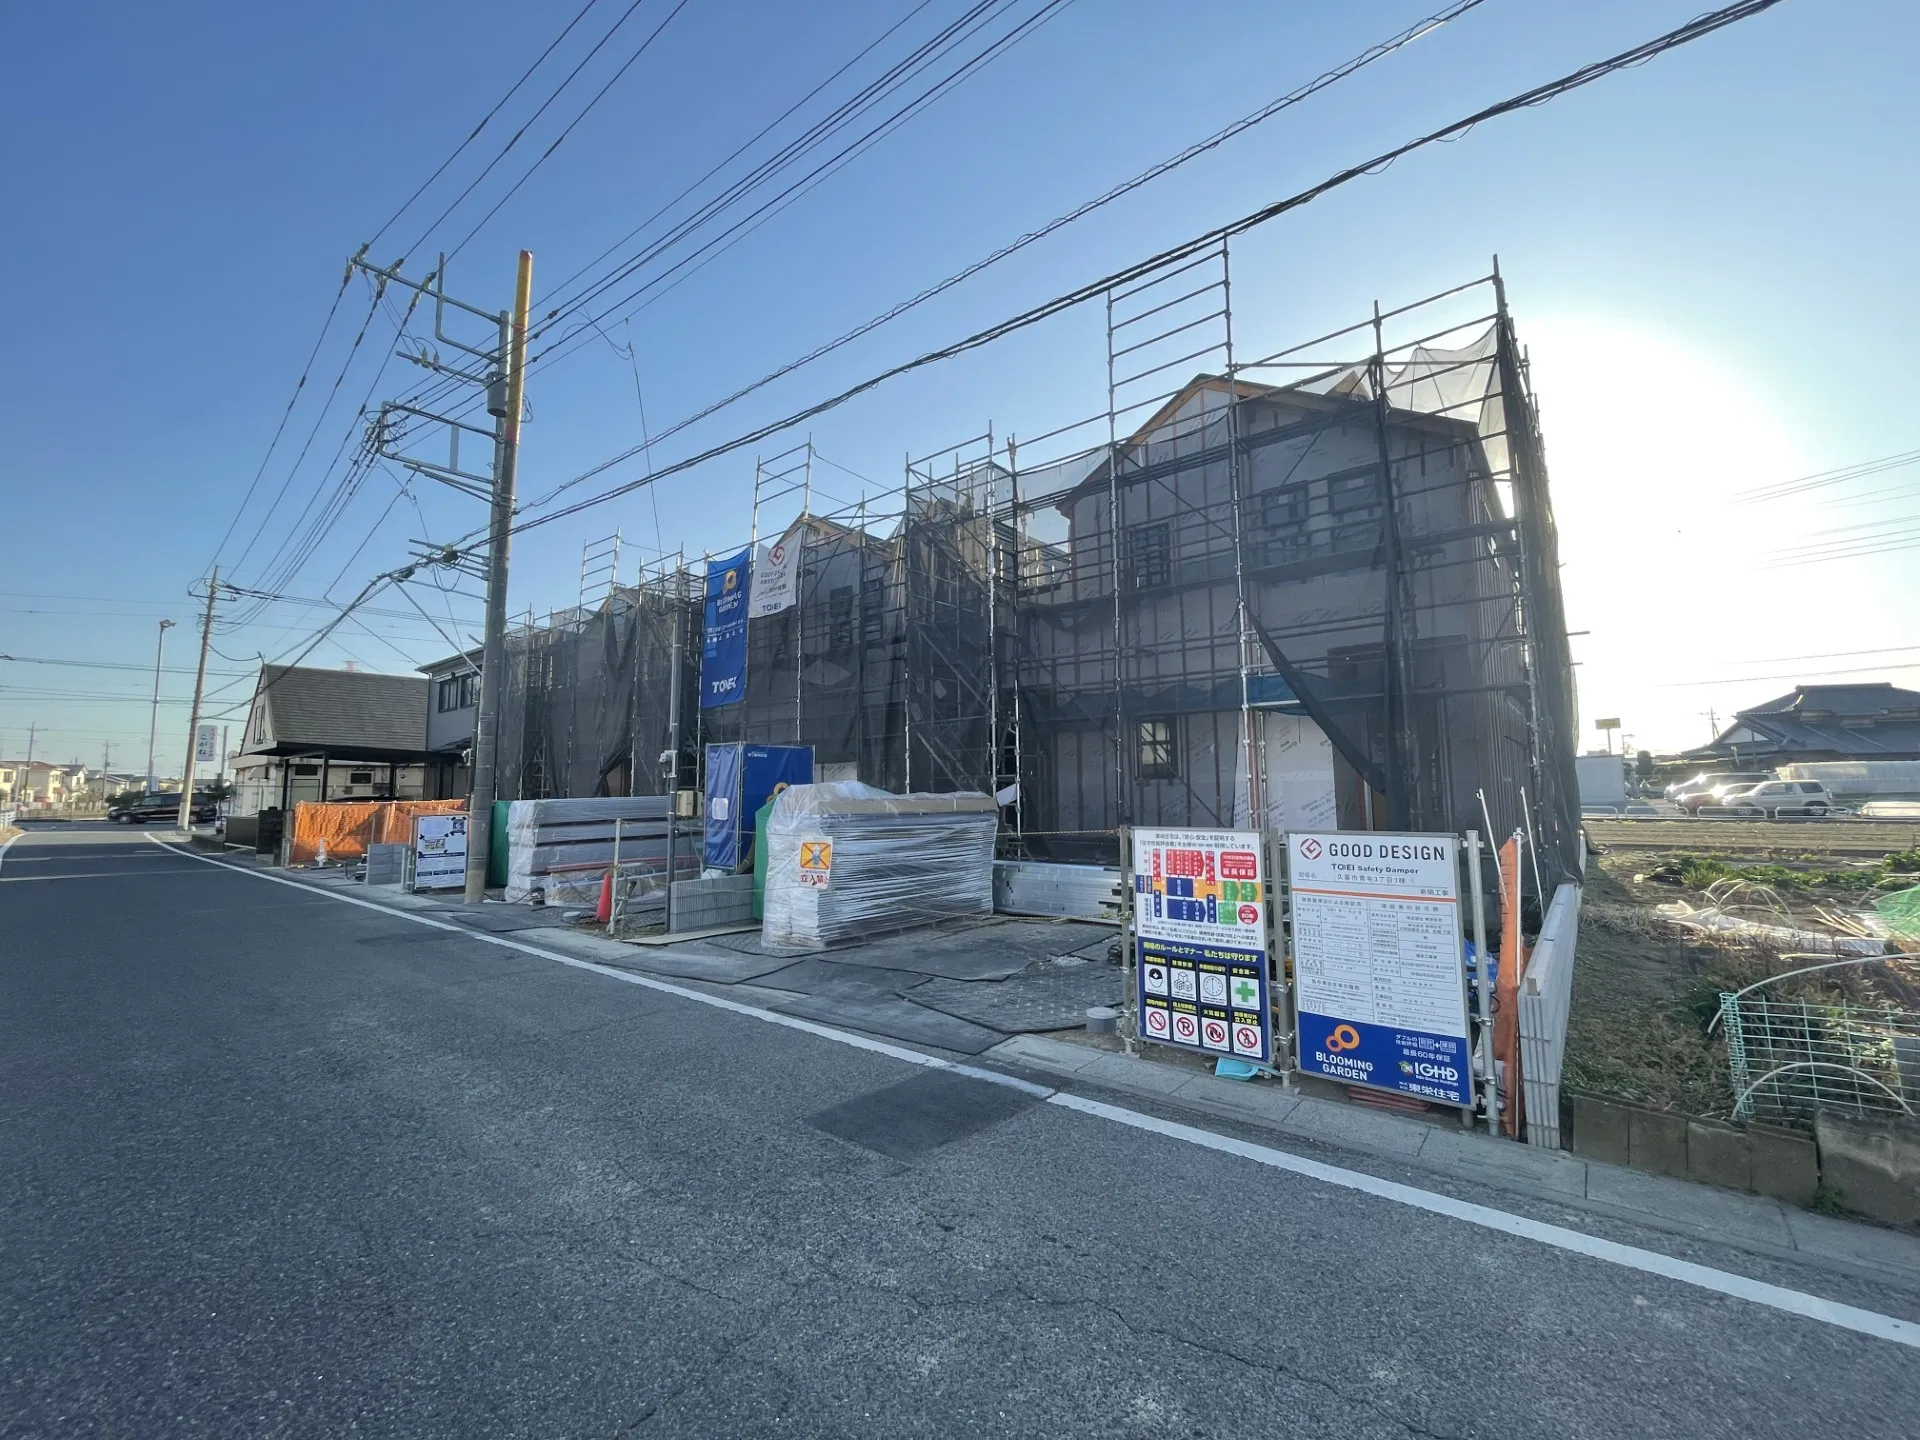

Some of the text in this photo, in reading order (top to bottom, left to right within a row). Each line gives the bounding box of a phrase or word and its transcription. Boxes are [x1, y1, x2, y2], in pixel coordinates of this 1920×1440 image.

[1329, 843, 1445, 861] GOOD DESIGN
[1357, 865, 1383, 875] Safety
[1385, 867, 1419, 875] Damper
[1204, 949, 1258, 962] 私たちは守ります
[1315, 1051, 1374, 1072] BLOOMING
[1322, 1063, 1368, 1081] GARDEN
[1408, 1083, 1460, 1102] 東栄住宅
